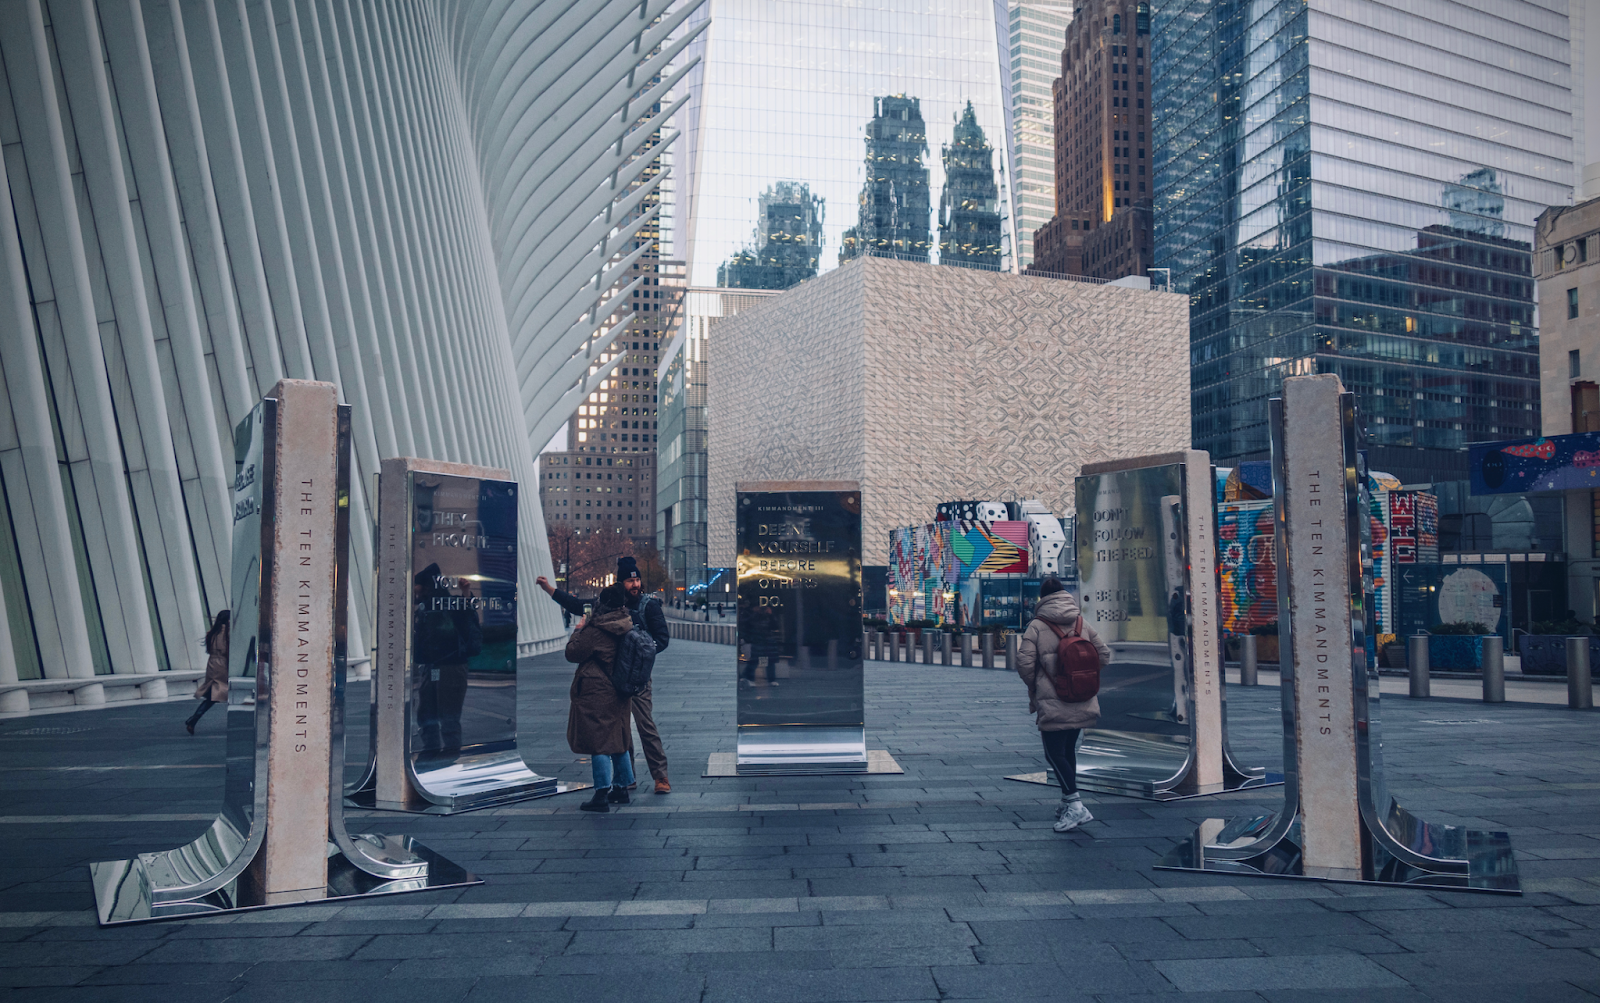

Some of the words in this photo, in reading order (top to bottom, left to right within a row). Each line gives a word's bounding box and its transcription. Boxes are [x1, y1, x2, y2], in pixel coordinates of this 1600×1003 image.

[300, 479, 313, 516] THE
[1308, 470, 1321, 506] THE
[432, 511, 468, 526] THEY
[1390, 493, 1416, 564] WTC
[758, 541, 835, 553] YOURSELF
[1094, 527, 1145, 542] FOLLOW
[1310, 519, 1323, 555] TEN
[299, 529, 312, 567] TEN
[1095, 548, 1119, 562] THE
[759, 560, 816, 571] BEFORE
[431, 575, 459, 589] YOU
[759, 595, 784, 607] DO.
[1096, 589, 1112, 602] BE
[1096, 609, 1132, 622] FEED.
[1201, 582, 1211, 695] KIMMANDMENTS
[387, 593, 395, 710] KIMMANDMENTS
[1312, 569, 1331, 735] KIMMANDMENTS
[295, 580, 311, 753] KIMMANDMENTS
